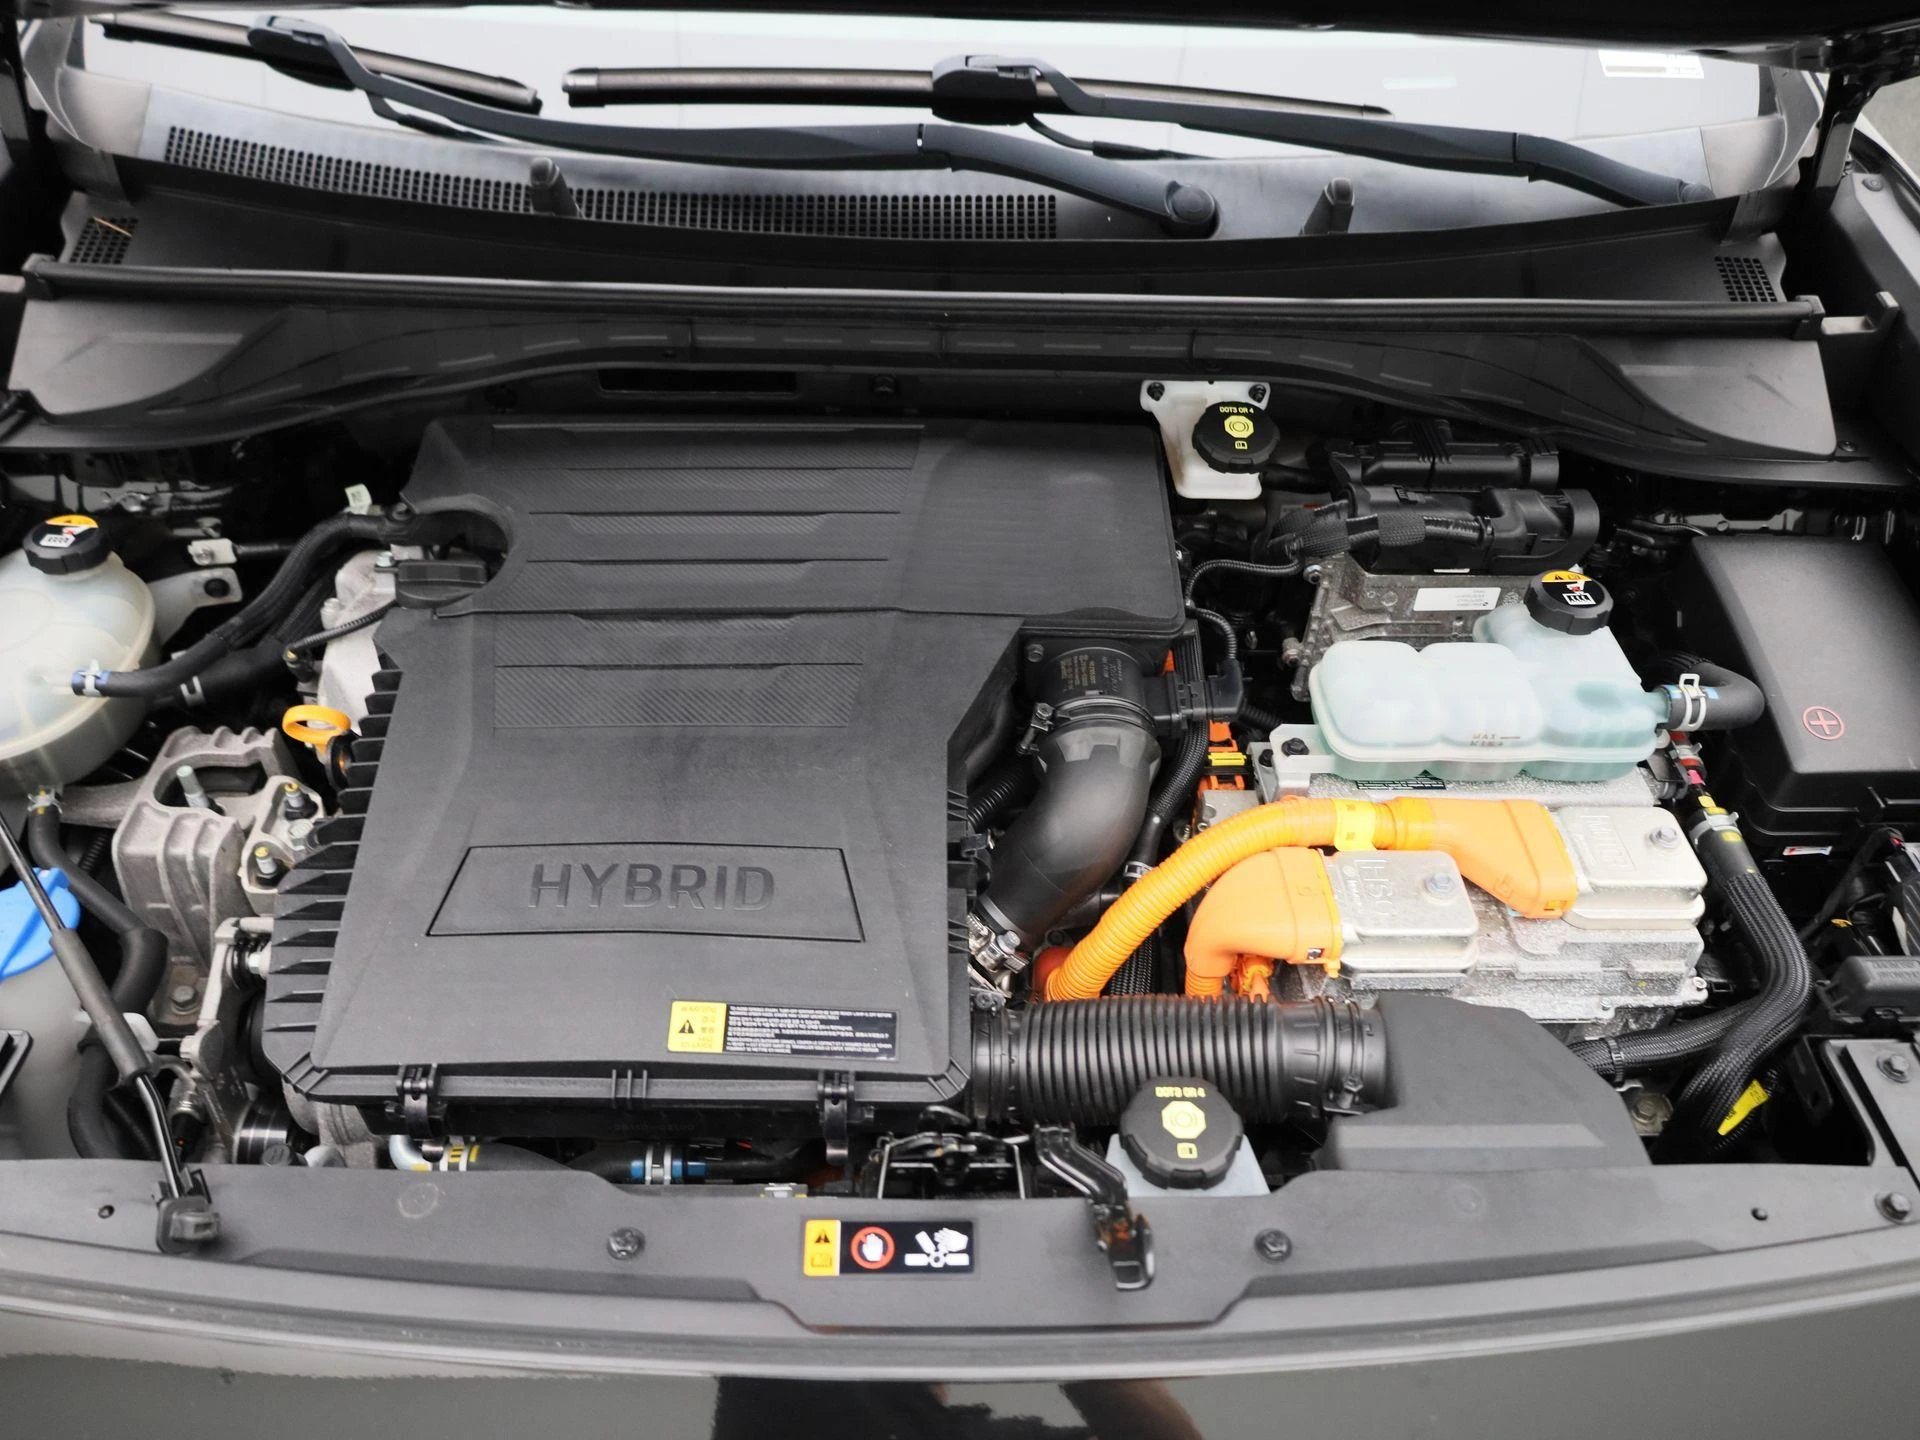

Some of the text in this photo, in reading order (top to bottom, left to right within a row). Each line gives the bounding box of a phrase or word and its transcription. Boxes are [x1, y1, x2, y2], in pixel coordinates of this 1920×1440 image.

[1238, 406, 1249, 414] OR
[527, 863, 775, 911] HYBRID
[1154, 1086, 1206, 1098] DOT3 OR 4
